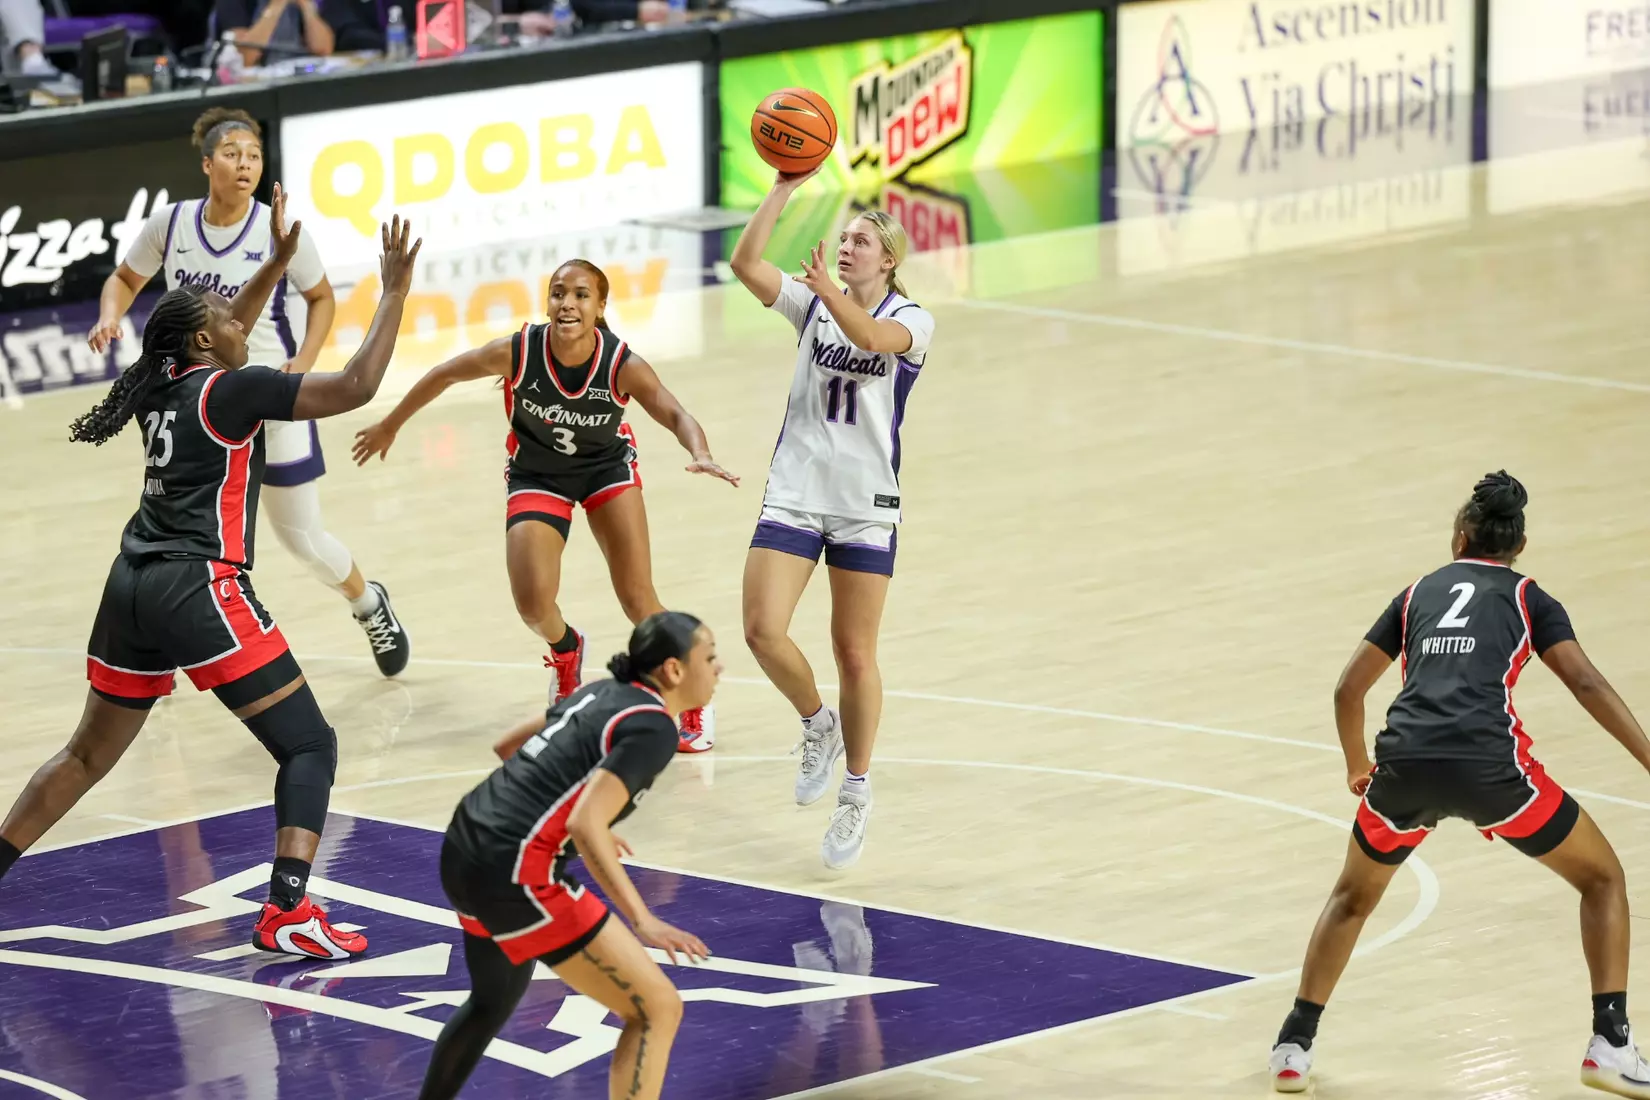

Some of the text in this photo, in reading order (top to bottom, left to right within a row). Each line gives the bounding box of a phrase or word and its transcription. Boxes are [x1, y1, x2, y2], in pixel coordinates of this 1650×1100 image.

[1238, 0, 1447, 52] Ascension
[1586, 8, 1650, 44] FRE
[1238, 43, 1456, 131] Via Christi
[760, 121, 805, 150] ELITE
[310, 104, 667, 238] QDOBA
[0, 205, 110, 287] izza
[175, 269, 251, 299] Wildca
[811, 337, 887, 378] Wildcats
[521, 398, 613, 428] CINCINNATI
[826, 375, 858, 426] 11
[143, 410, 178, 468] 25
[552, 427, 578, 456] 3
[1436, 582, 1476, 629] 2
[1421, 636, 1476, 655] WHITTED
